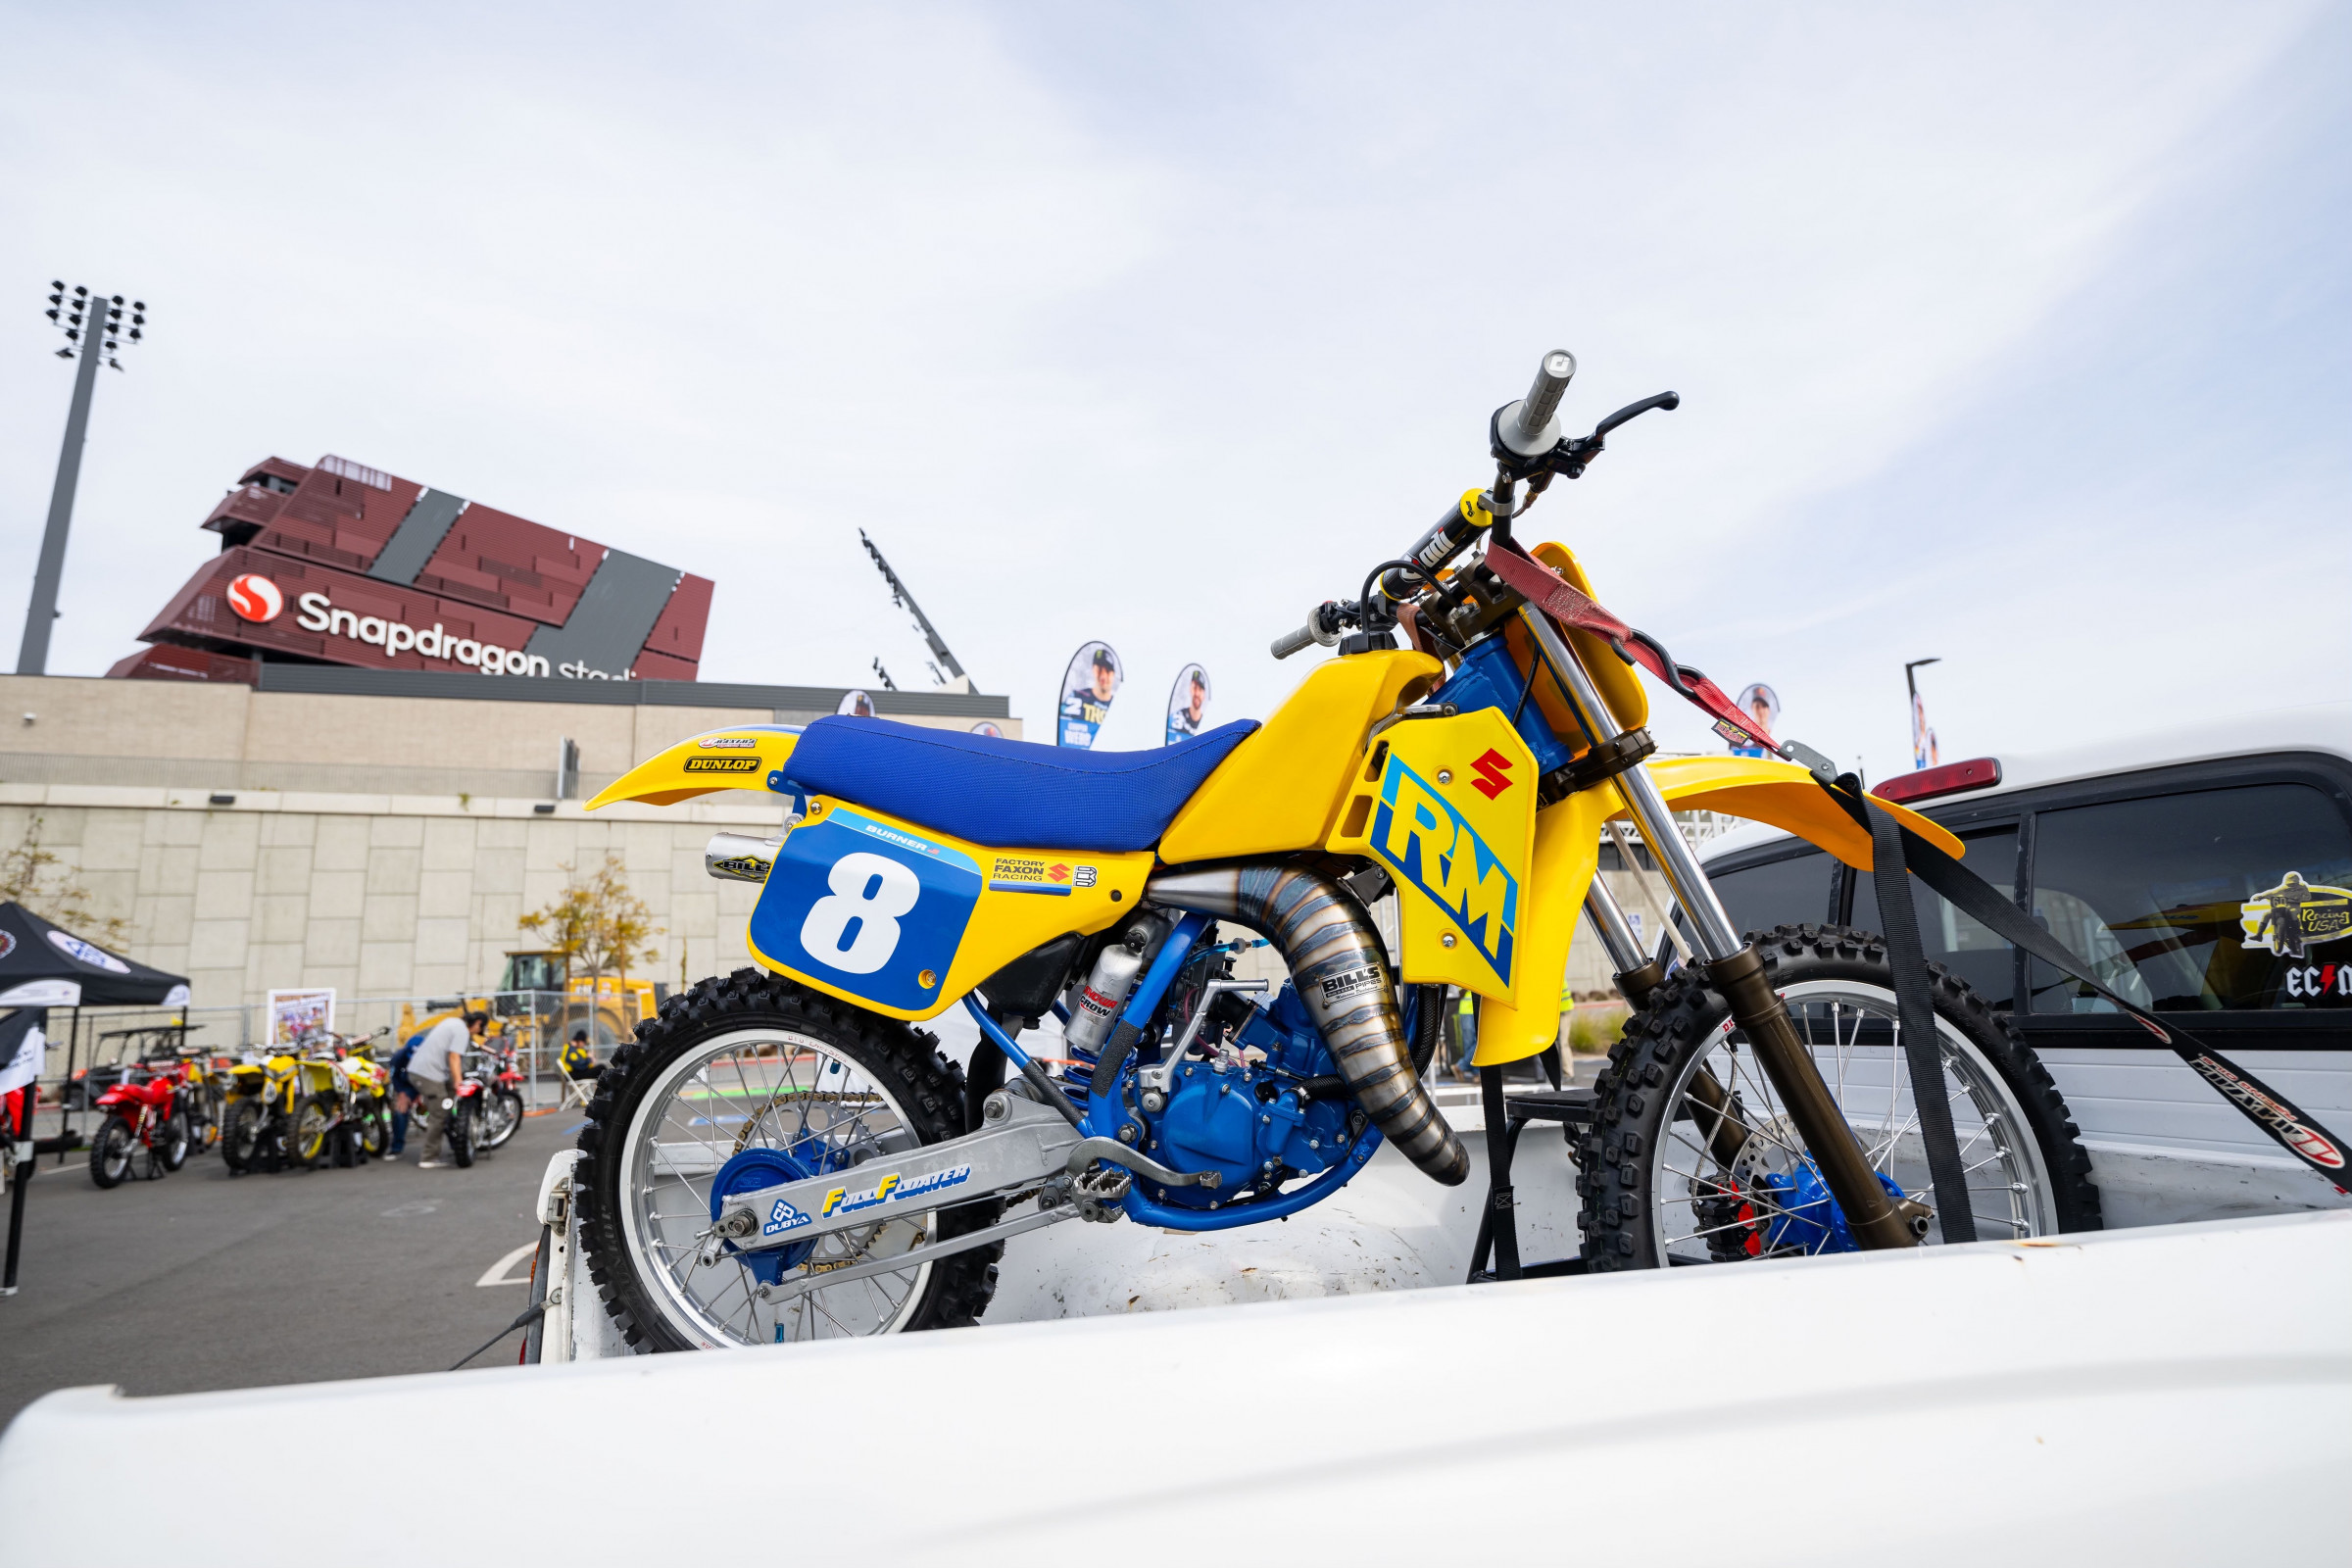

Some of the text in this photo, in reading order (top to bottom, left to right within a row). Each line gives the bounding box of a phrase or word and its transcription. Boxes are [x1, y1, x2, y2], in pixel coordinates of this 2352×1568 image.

[296, 591, 551, 676] Snapdragon
[688, 759, 758, 770] DUNLOP
[864, 824, 928, 852] BURNER
[994, 864, 1045, 875] FAXON
[996, 858, 1045, 866] FACTORY
[1384, 768, 1510, 966] RM
[993, 872, 1043, 881] RACING
[800, 852, 920, 975] 8
[2303, 908, 2350, 925] Racing
[2308, 920, 2340, 932] USA
[1322, 965, 1381, 994] BILL'S
[1081, 996, 1110, 1016] CROW
[765, 1215, 809, 1234] DUBYA
